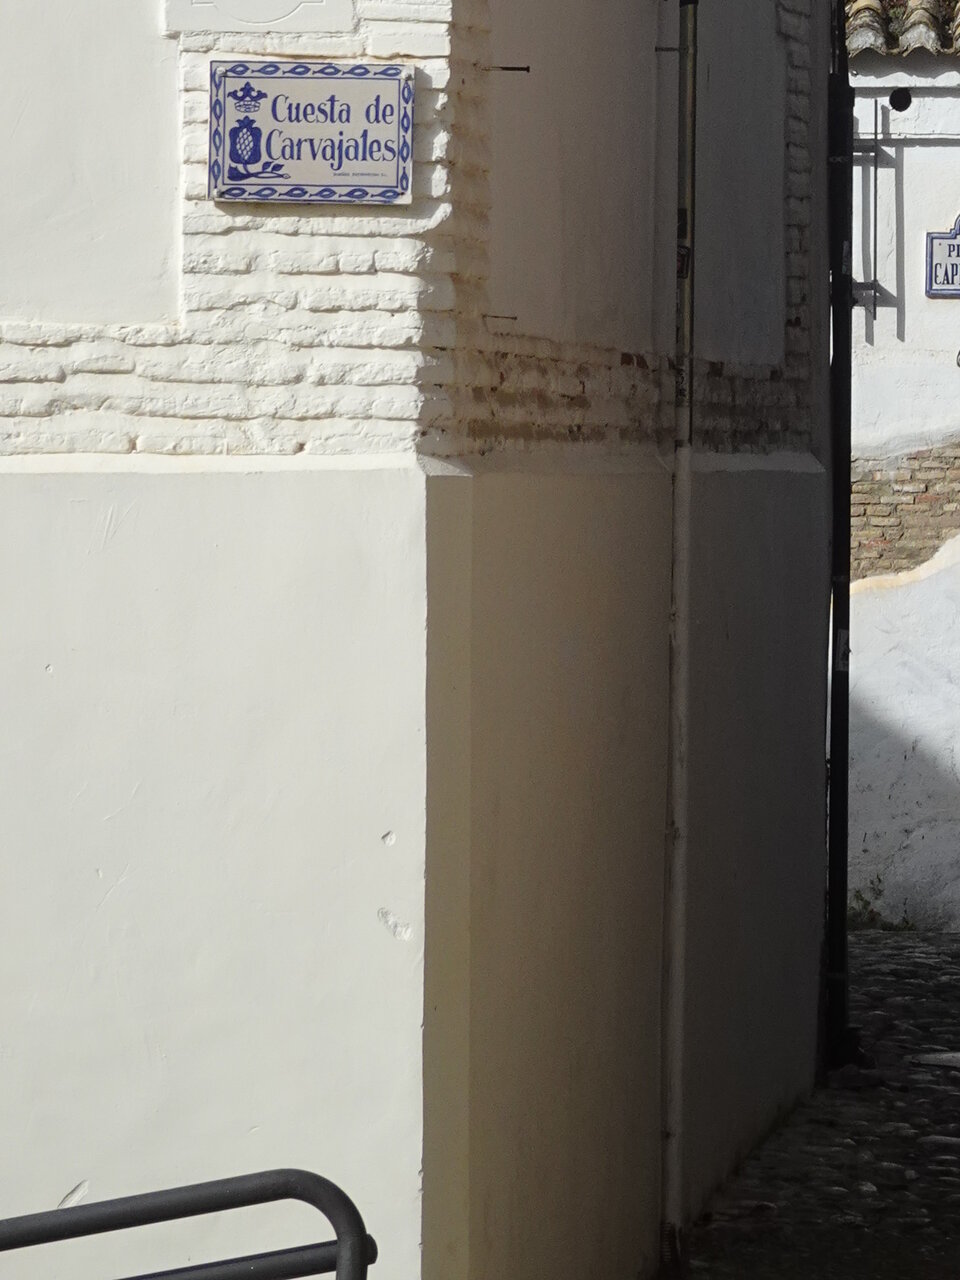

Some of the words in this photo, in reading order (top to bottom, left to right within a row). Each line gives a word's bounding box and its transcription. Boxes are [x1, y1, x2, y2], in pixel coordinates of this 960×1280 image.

[271, 93, 351, 124] Cuesta
[365, 94, 395, 125] de
[265, 128, 397, 171] Carvajales
